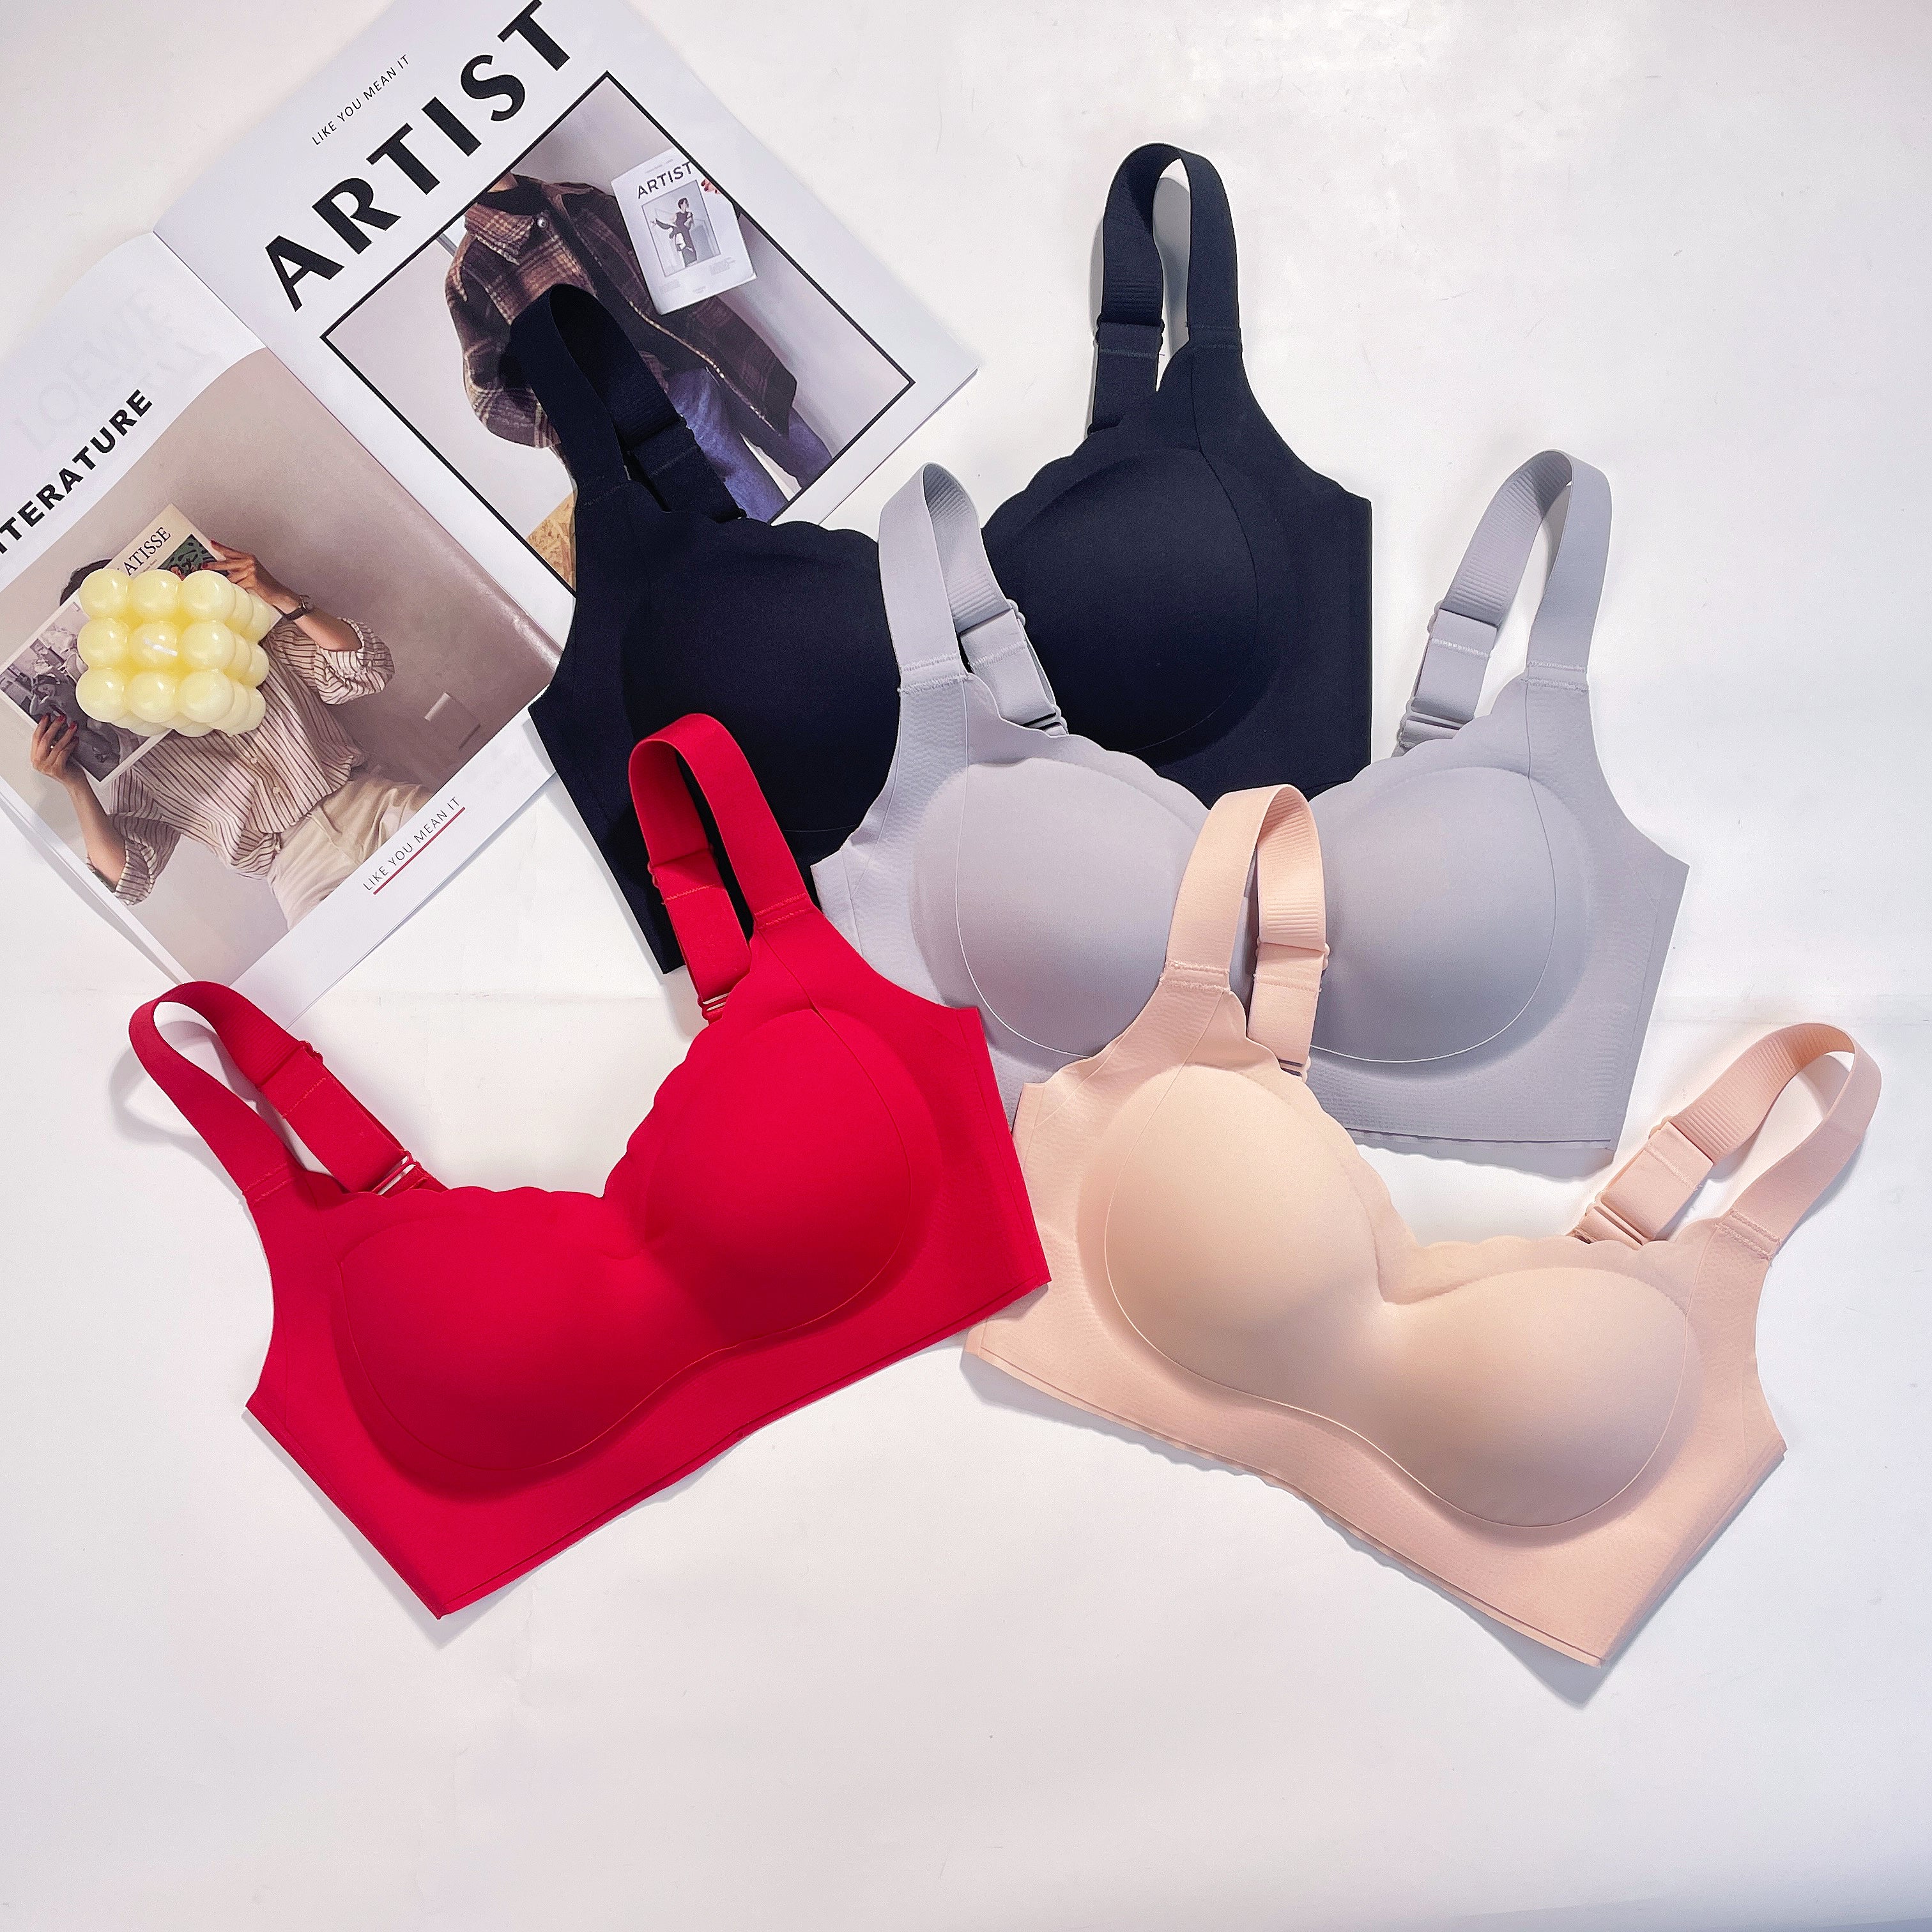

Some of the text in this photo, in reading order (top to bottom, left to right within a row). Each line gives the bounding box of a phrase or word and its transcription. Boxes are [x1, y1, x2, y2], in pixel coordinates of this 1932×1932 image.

[312, 54, 409, 145] LIKE YOU MEAN IT
[265, 0, 571, 312] ARTIST
[638, 161, 691, 199] ARTIST
[121, 526, 171, 576] ATISSE
[362, 797, 460, 891] LIKE YOU MEAN IT
